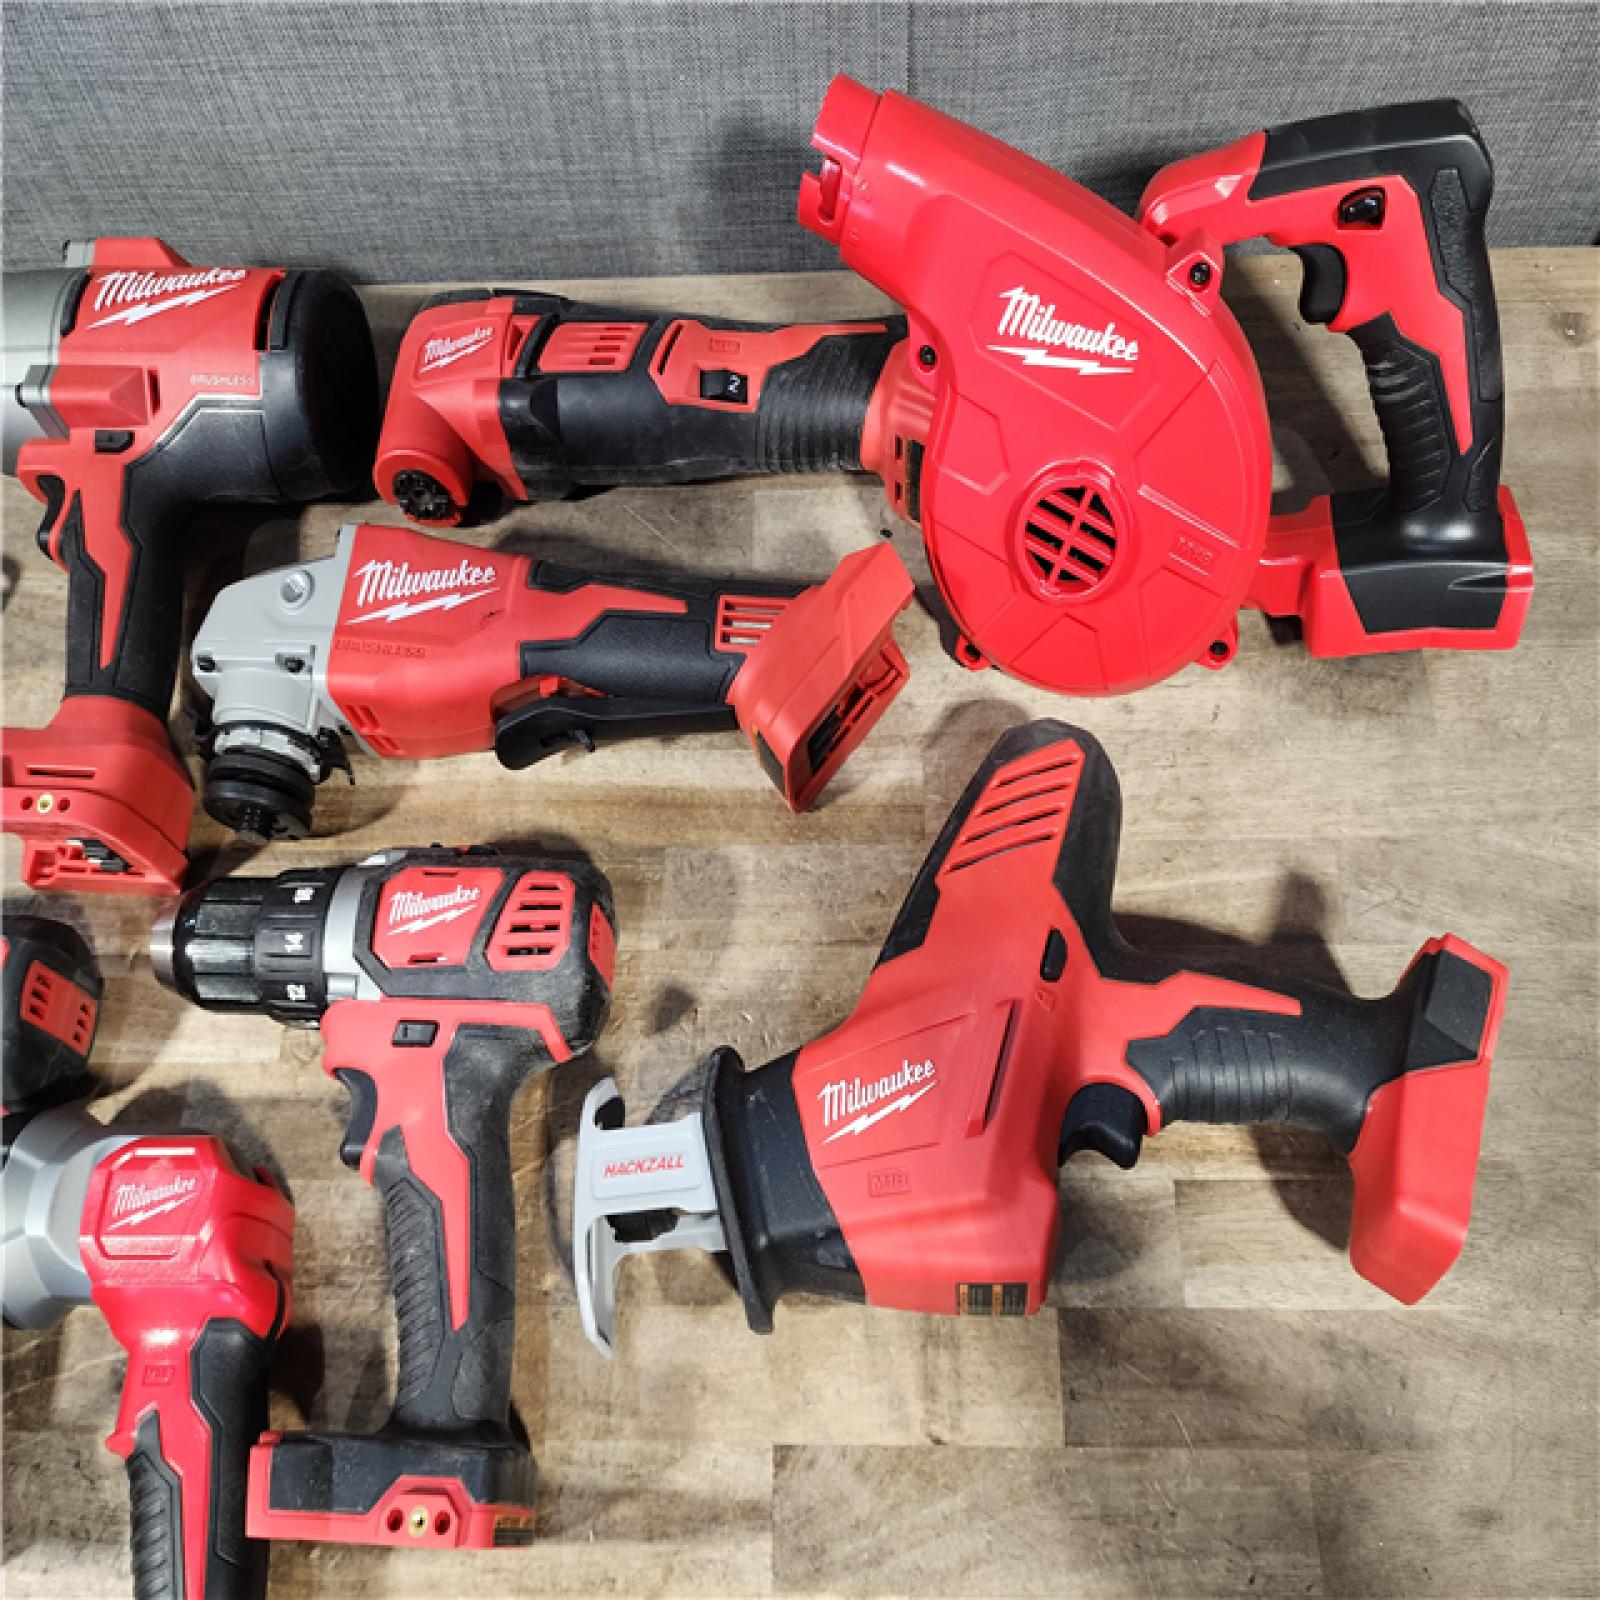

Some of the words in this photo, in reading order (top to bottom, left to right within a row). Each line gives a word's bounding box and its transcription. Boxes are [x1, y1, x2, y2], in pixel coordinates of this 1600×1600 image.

[94, 267, 246, 312] Milwaukee
[424, 327, 493, 364] Milwaukee
[998, 286, 1139, 361] Milwaukee
[727, 375, 741, 393] 2
[353, 559, 496, 607] Milwaukee
[388, 884, 480, 925] Milwaukee
[285, 932, 304, 952] 14
[816, 1059, 936, 1128] Milwaukee
[112, 1174, 196, 1218] Milwaukee
